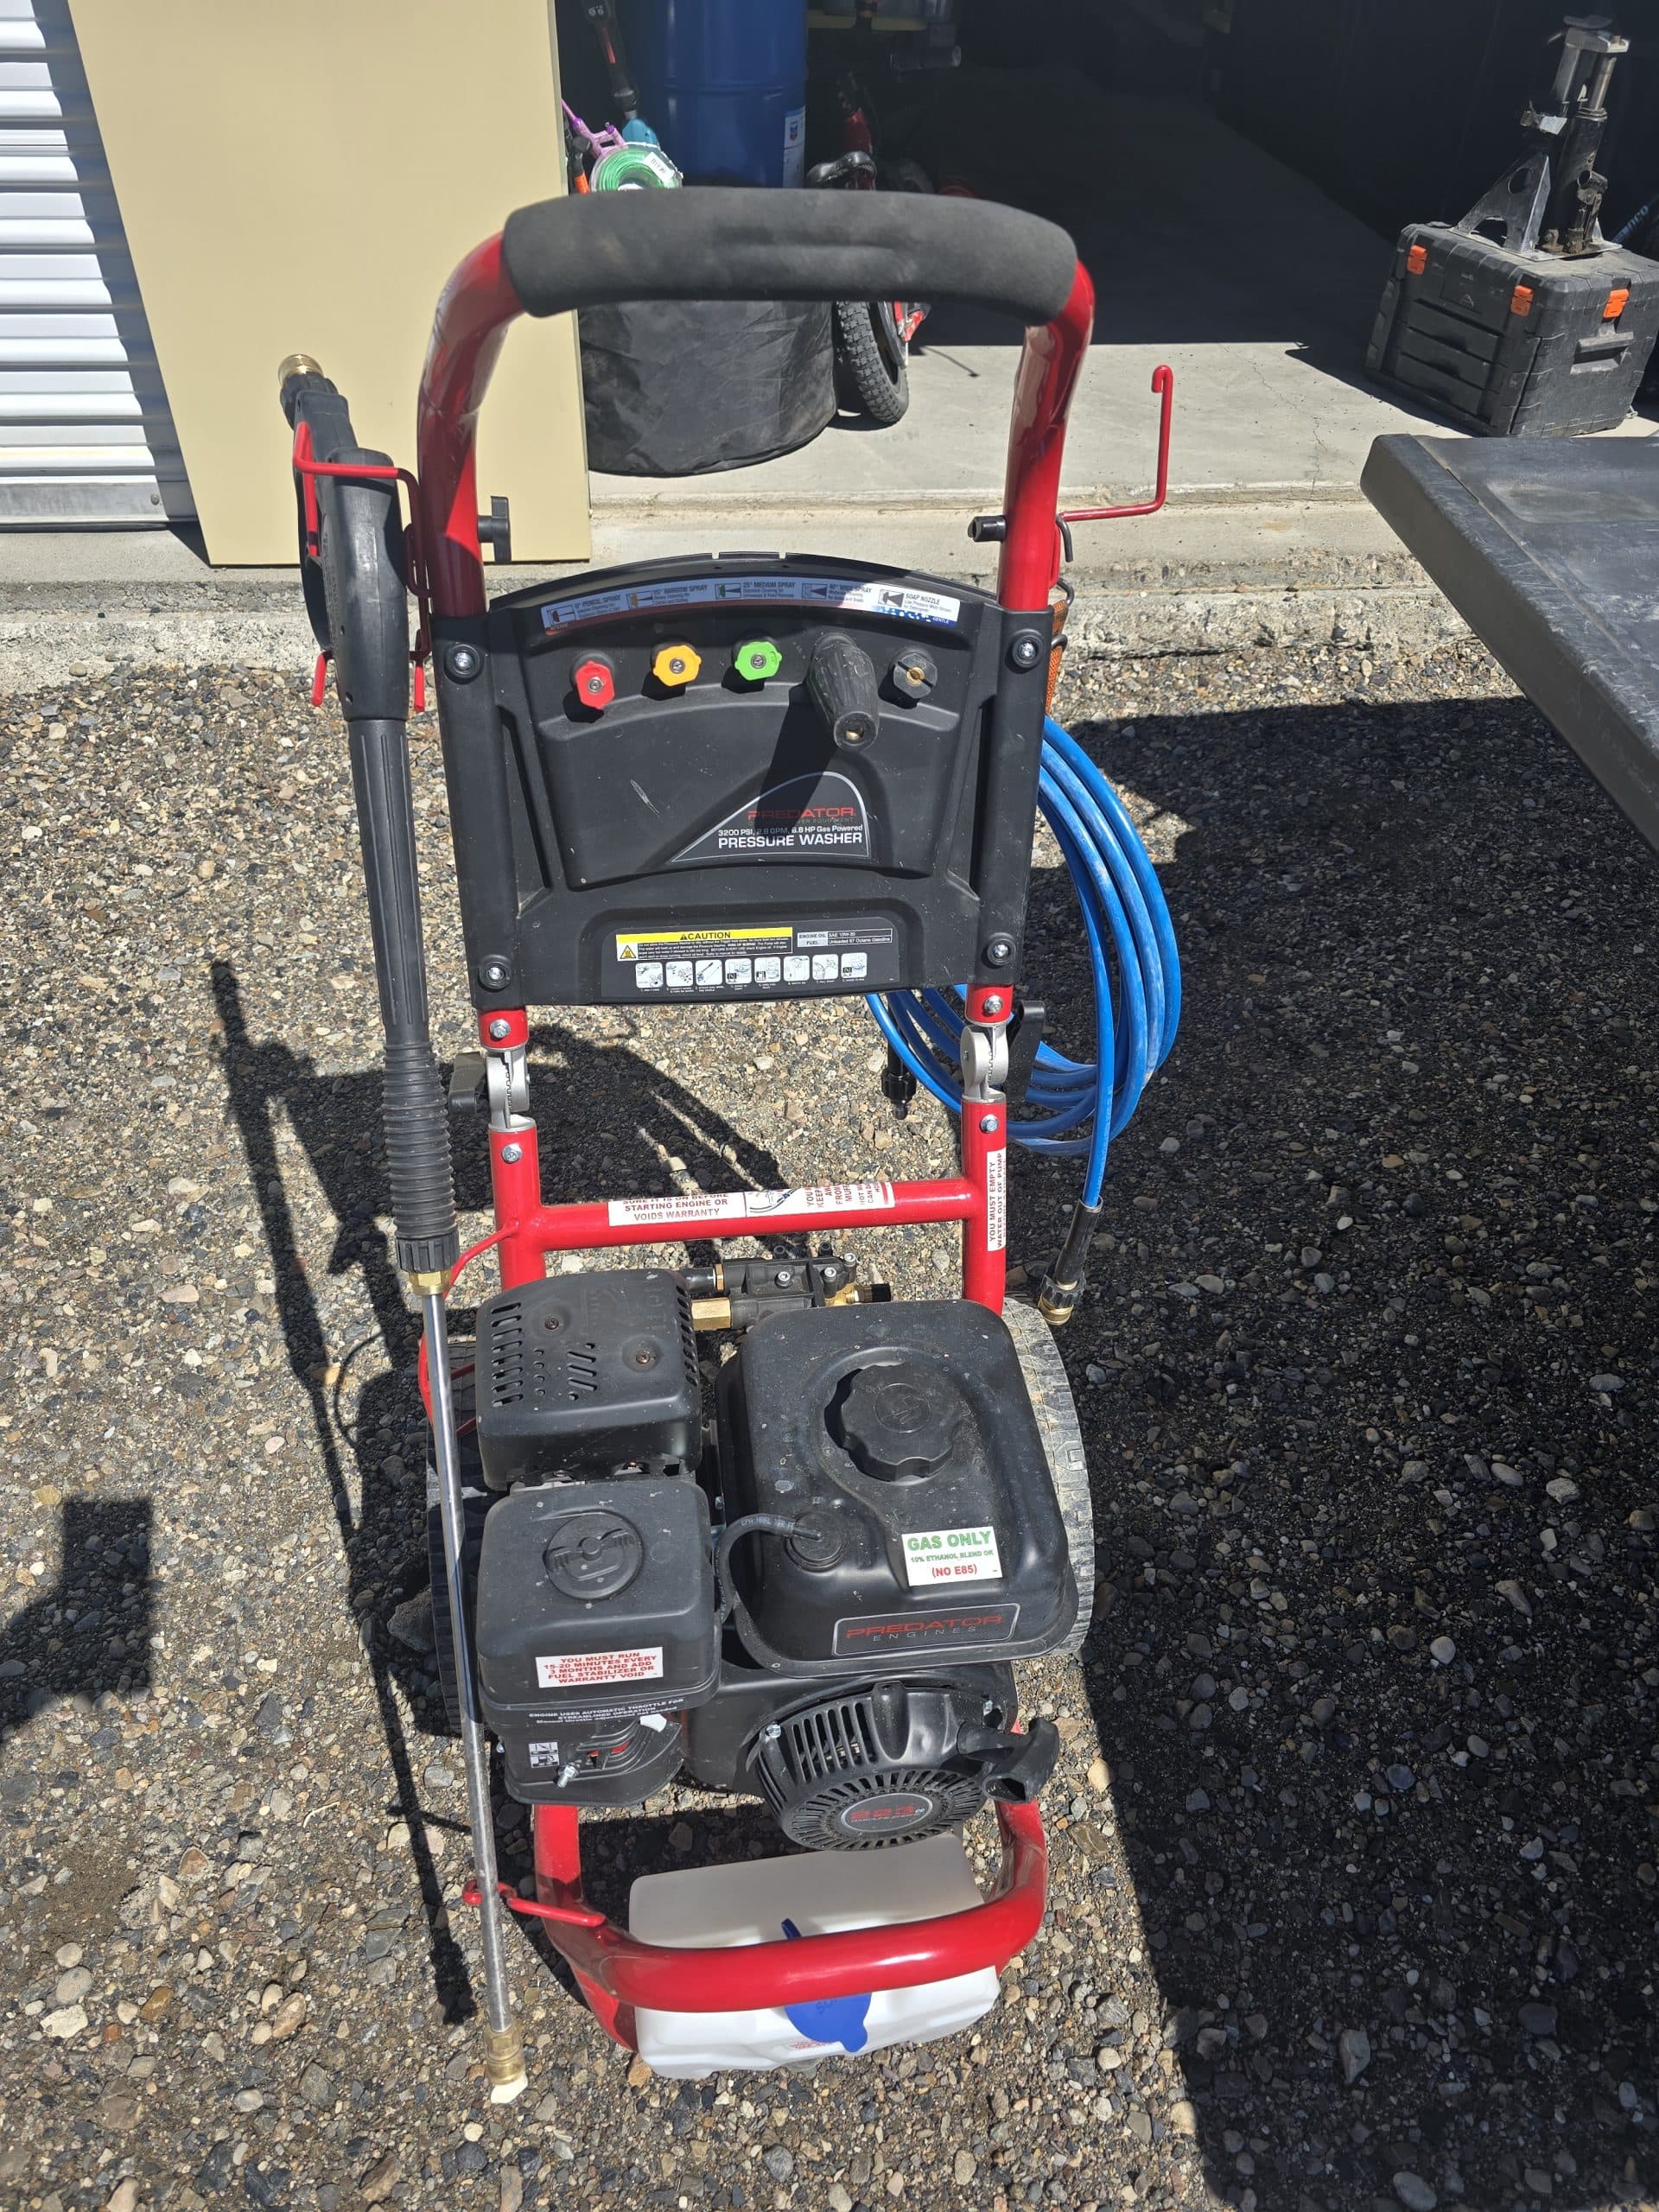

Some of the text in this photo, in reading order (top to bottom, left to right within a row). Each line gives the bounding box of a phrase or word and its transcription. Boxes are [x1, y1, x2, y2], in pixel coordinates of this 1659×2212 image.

[920, 594, 941, 605] NOZZLE
[747, 806, 855, 820] PREDATOR
[718, 832, 863, 849] PRESSURE WASHER
[688, 931, 731, 941] CAUTION
[997, 1181, 1002, 1193] OF
[625, 1202, 672, 1212] STARTING
[676, 1199, 711, 1208] ENGINE
[815, 1190, 824, 1208] KEEP
[634, 1208, 720, 1221] VOIDS WARRANTY
[907, 1530, 991, 1552] GAS ONLY
[926, 1553, 958, 1562] ETHANOL
[960, 1551, 982, 1560] BLEND
[931, 1563, 978, 1579] (NO E85)
[846, 1615, 1004, 1639] PREDATOR
[873, 1625, 978, 1642] ENGINES
[574, 1659, 615, 1669] MINUTES
[616, 1655, 658, 1664] EVERY
[558, 1675, 617, 1684] WARRANTY
[577, 1668, 632, 1678] STABILIZER
[613, 1707, 657, 1716] OPERATION
[627, 1701, 667, 1710] THROTTLE
